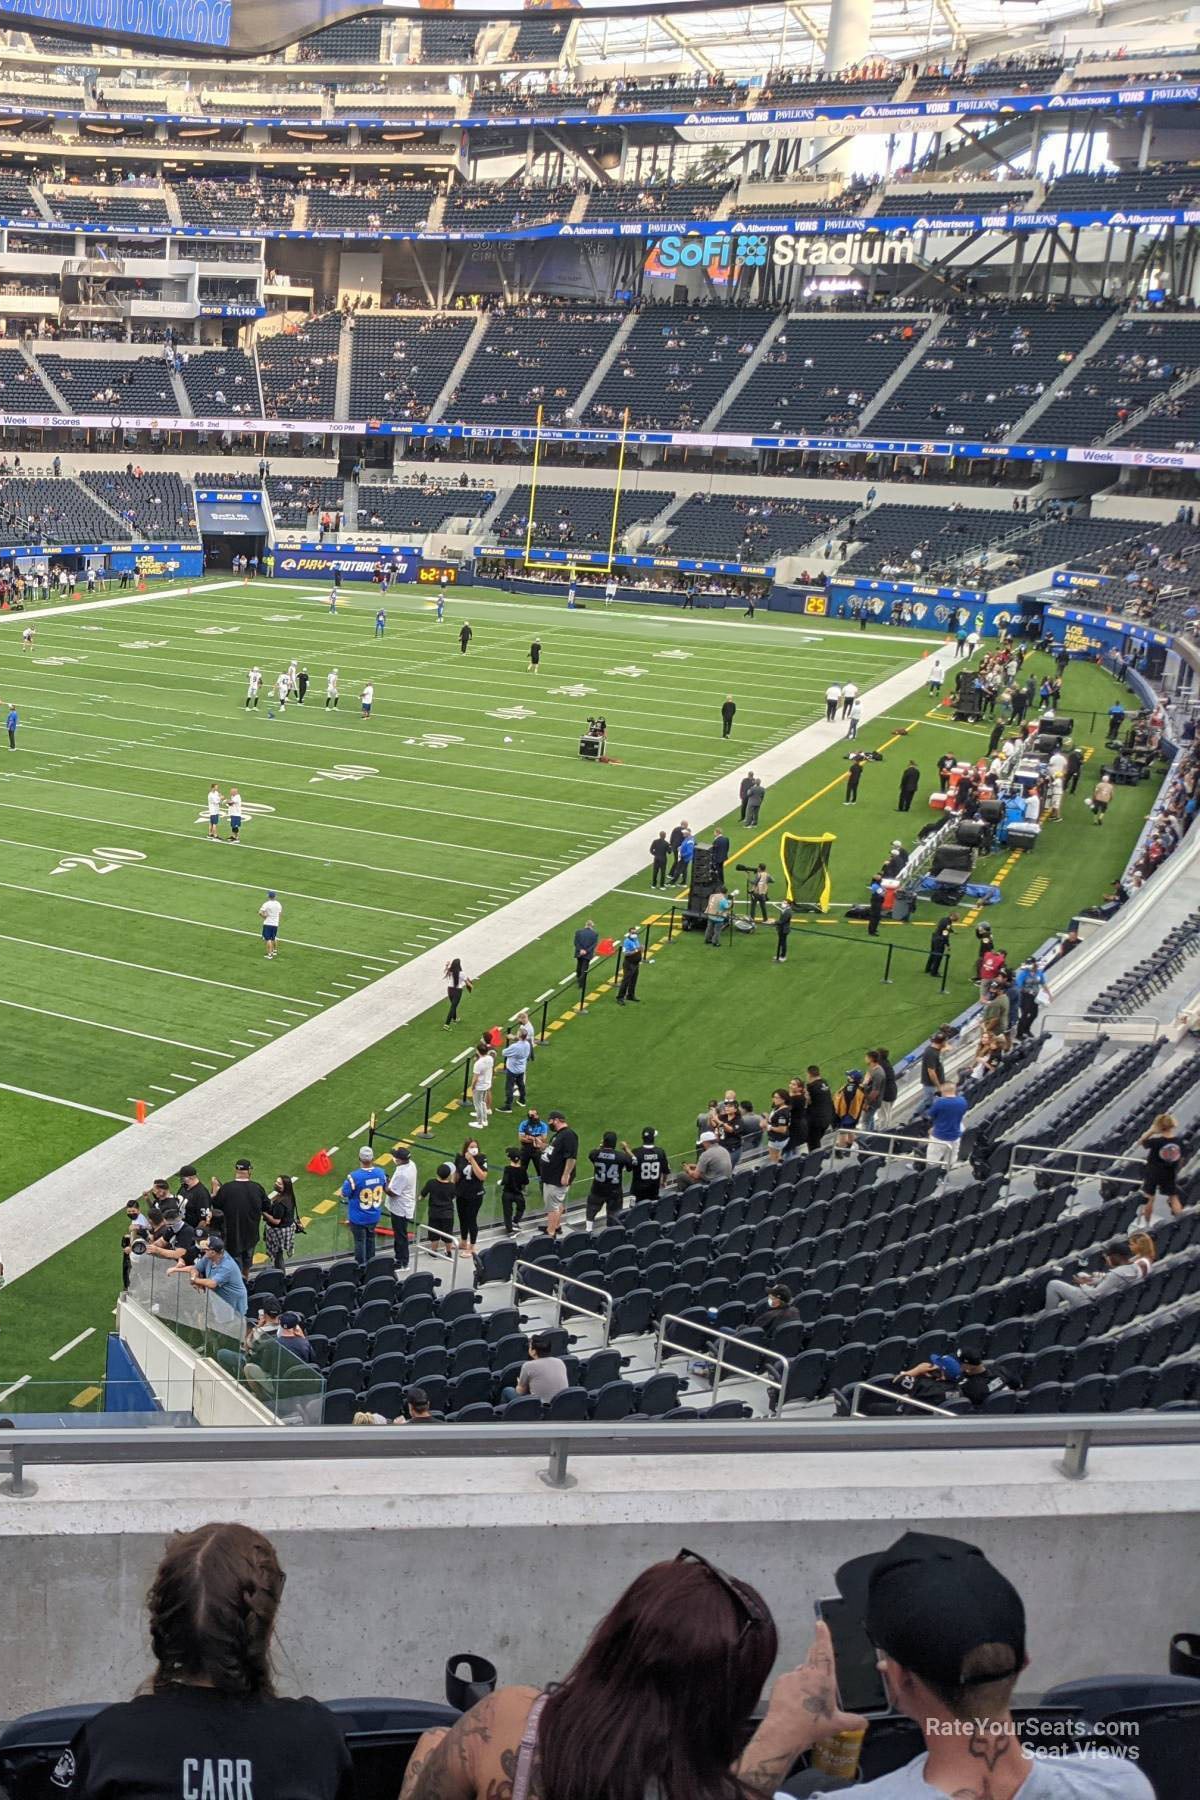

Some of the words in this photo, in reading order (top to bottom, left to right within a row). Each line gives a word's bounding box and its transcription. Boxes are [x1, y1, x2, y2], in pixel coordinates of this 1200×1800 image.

[1065, 96, 1112, 106] Albertsons
[1119, 91, 1144, 103] VONS
[1152, 88, 1199, 101] PAVILIONS
[877, 107, 919, 116] Albertsons
[926, 103, 950, 114] VONS
[956, 100, 999, 112] PAVILIONS
[700, 115, 740, 124] Albertsons
[746, 112, 769, 122] VONS
[775, 109, 814, 120] PAVILIONS
[929, 219, 975, 229] Albertsons
[982, 216, 1008, 227] VONS
[1013, 213, 1058, 226] PAVILIONS
[1127, 214, 1176, 224] Albertsons
[574, 226, 614, 235] Albertsons
[620, 224, 642, 234] VONS
[648, 223, 687, 234] PAVILIONS
[747, 224, 788, 233] Albertsons
[795, 221, 818, 232] VONS
[824, 219, 866, 231] PAVILIONS
[660, 235, 731, 267] SoFi
[773, 234, 914, 266] Stadium
[226, 307, 257, 316] $11,140
[3, 416, 28, 425] Week
[52, 417, 81, 427] Scores
[207, 420, 220, 429] 2nd
[328, 424, 343, 432] 7:00
[344, 424, 355, 432] PM
[471, 428, 495, 437] 62:17
[982, 447, 1009, 455] RAMS
[1083, 451, 1114, 462] Week
[1146, 453, 1184, 466] Scores
[135, 555, 155, 563] LOS
[567, 552, 592, 560] RAMS
[654, 559, 679, 567] RAMS
[741, 565, 766, 574] RAMS
[830, 578, 856, 586] RAMS
[1069, 575, 1100, 587] RAMS
[912, 587, 939, 596] RAMS
[807, 596, 825, 611] 25
[316, 764, 380, 783] 40
[59, 846, 148, 875] 20
[462, 1164, 473, 1180] 4
[594, 1162, 620, 1184] 34
[640, 1161, 661, 1180] 89
[359, 1187, 384, 1210] 99
[182, 1758, 252, 1800] CARR
